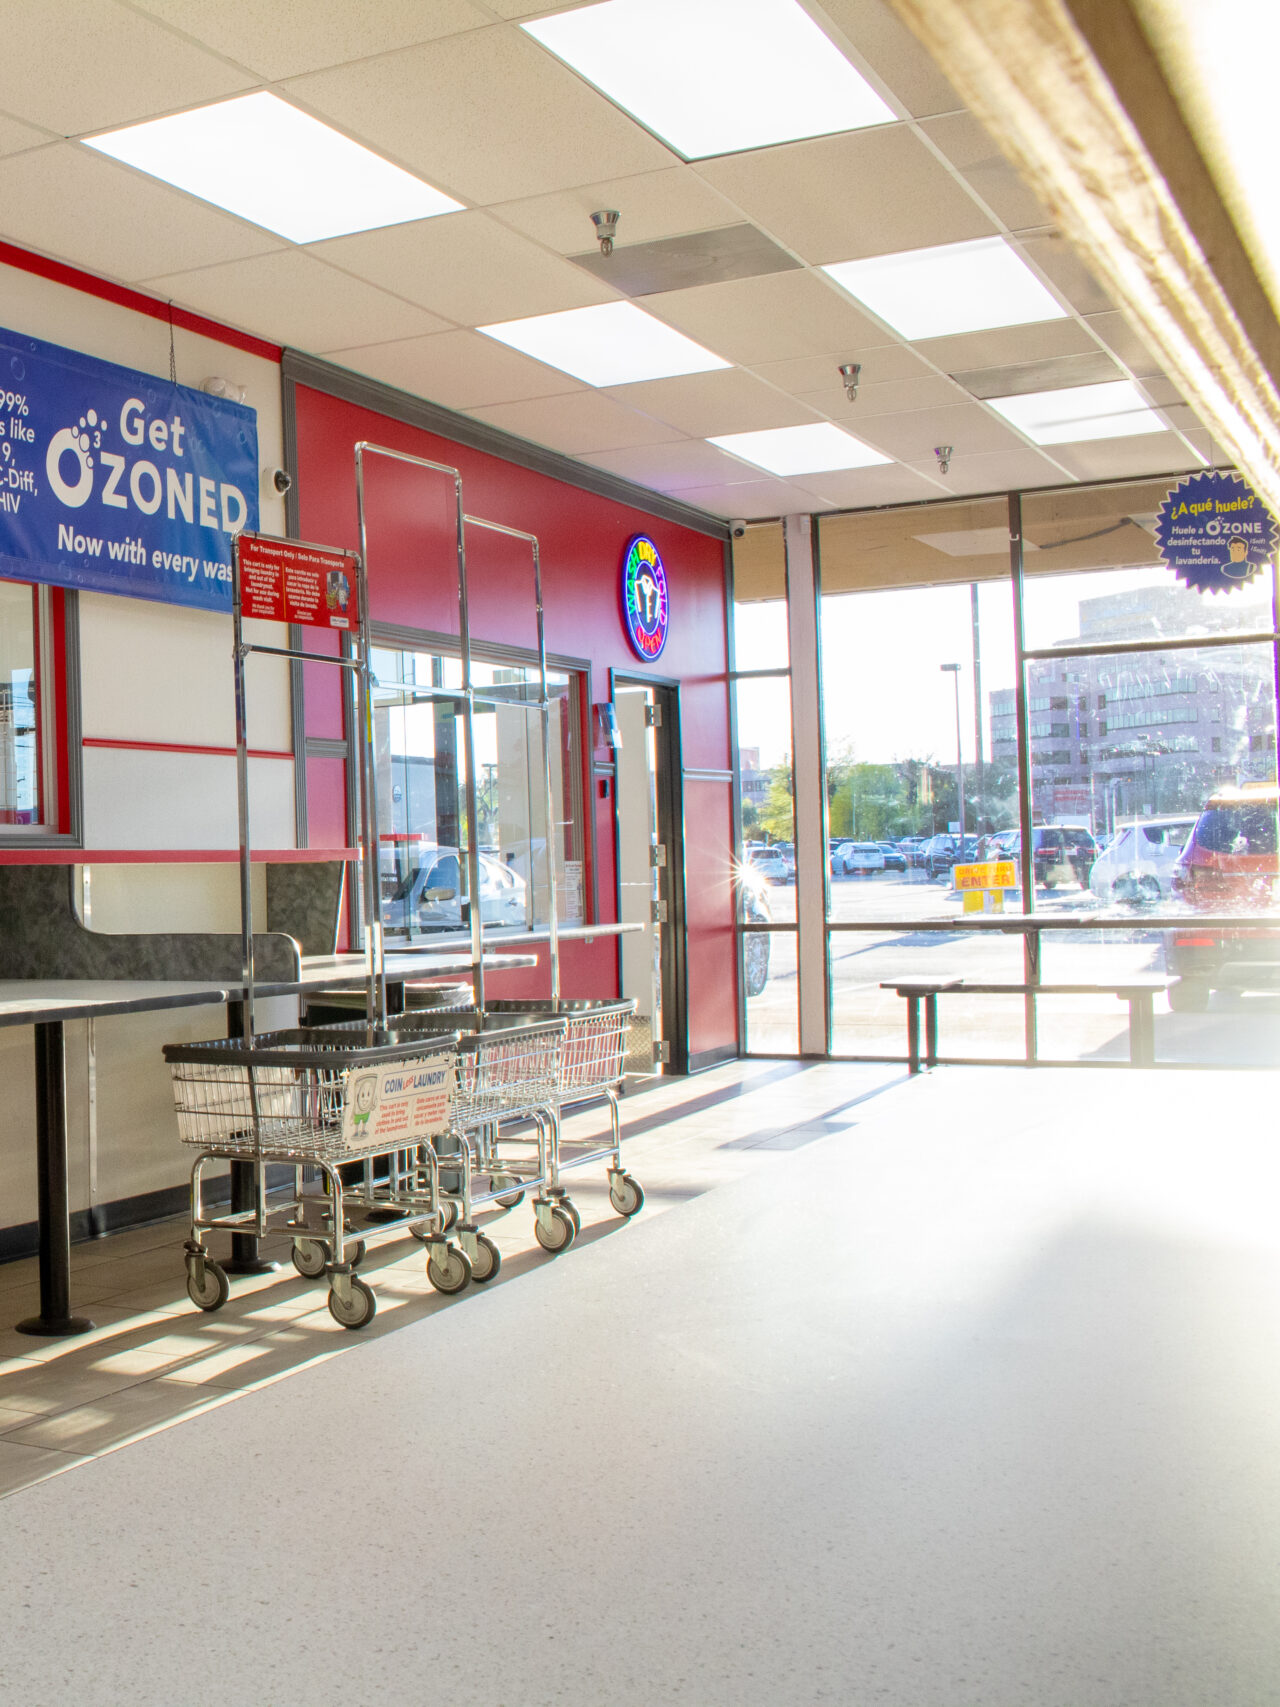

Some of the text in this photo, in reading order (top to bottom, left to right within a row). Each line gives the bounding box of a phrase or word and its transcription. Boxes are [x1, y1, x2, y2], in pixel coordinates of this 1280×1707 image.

[10, 419, 35, 443] like
[119, 397, 185, 457] Get
[1189, 498, 1213, 517] qué
[1215, 495, 1255, 513] huele?
[1171, 525, 1196, 535] Huele
[1167, 537, 1226, 546] desinfectando
[1192, 547, 1201, 556] tu
[58, 523, 233, 583] Now with every was
[250, 543, 259, 552] For
[259, 545, 283, 558] Transport
[284, 550, 295, 560] Only
[308, 555, 320, 563] Para
[635, 626, 663, 654] OPEN
[961, 874, 1010, 888] ENTER
[384, 1078, 403, 1094] COIN
[413, 1070, 446, 1089] LAUNDRY
